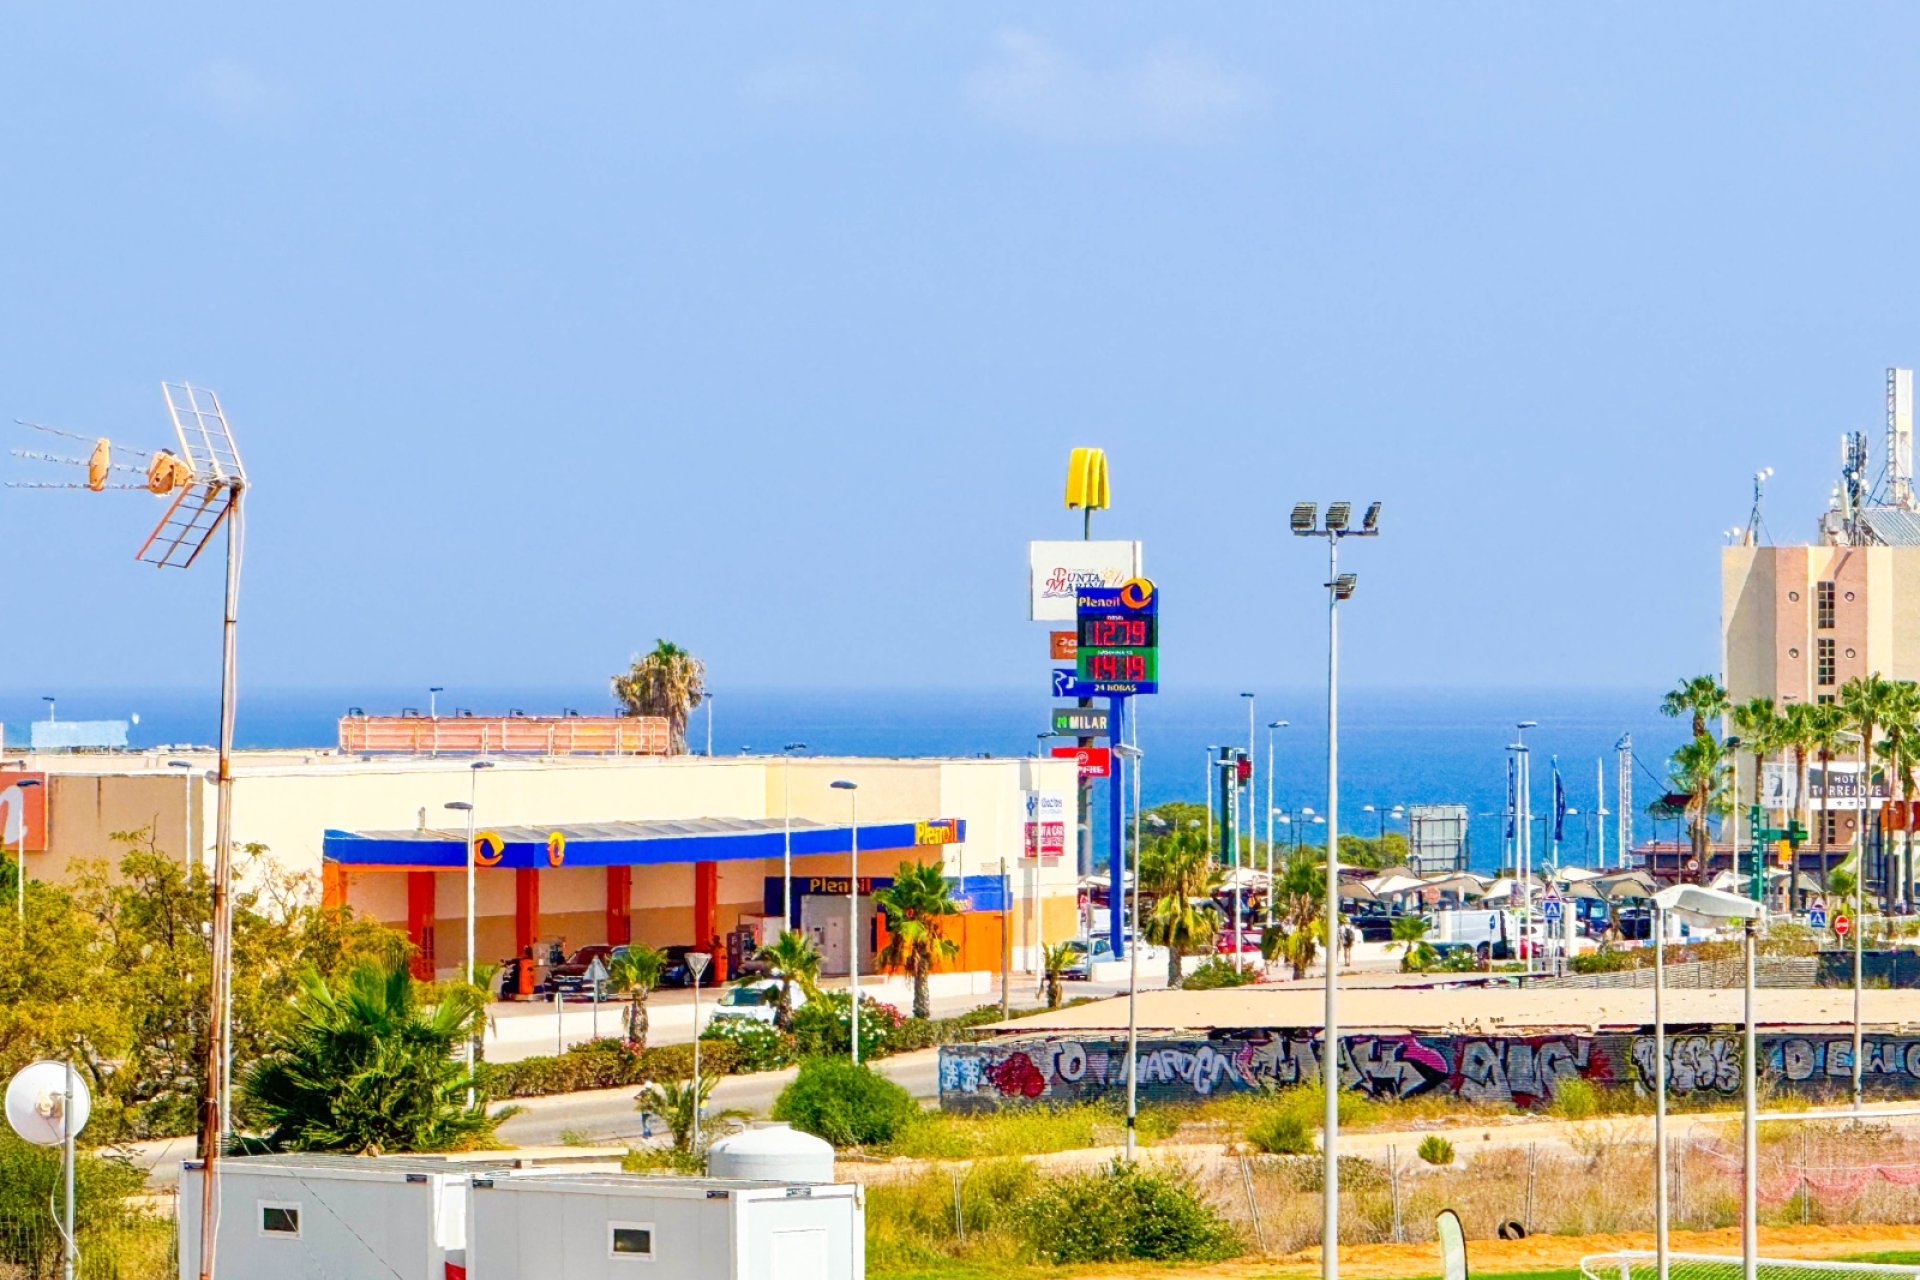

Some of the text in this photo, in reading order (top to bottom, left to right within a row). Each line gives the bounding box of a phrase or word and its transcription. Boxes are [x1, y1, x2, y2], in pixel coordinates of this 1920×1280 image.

[1053, 567, 1101, 582] PUNTA
[1078, 596, 1120, 607] Plenoil
[1107, 684, 1137, 692] HORAS
[1069, 716, 1107, 730] MILAR
[1227, 749, 1235, 828] FRMACIA
[915, 818, 958, 845] Plenoil
[810, 877, 871, 893] Plenil
